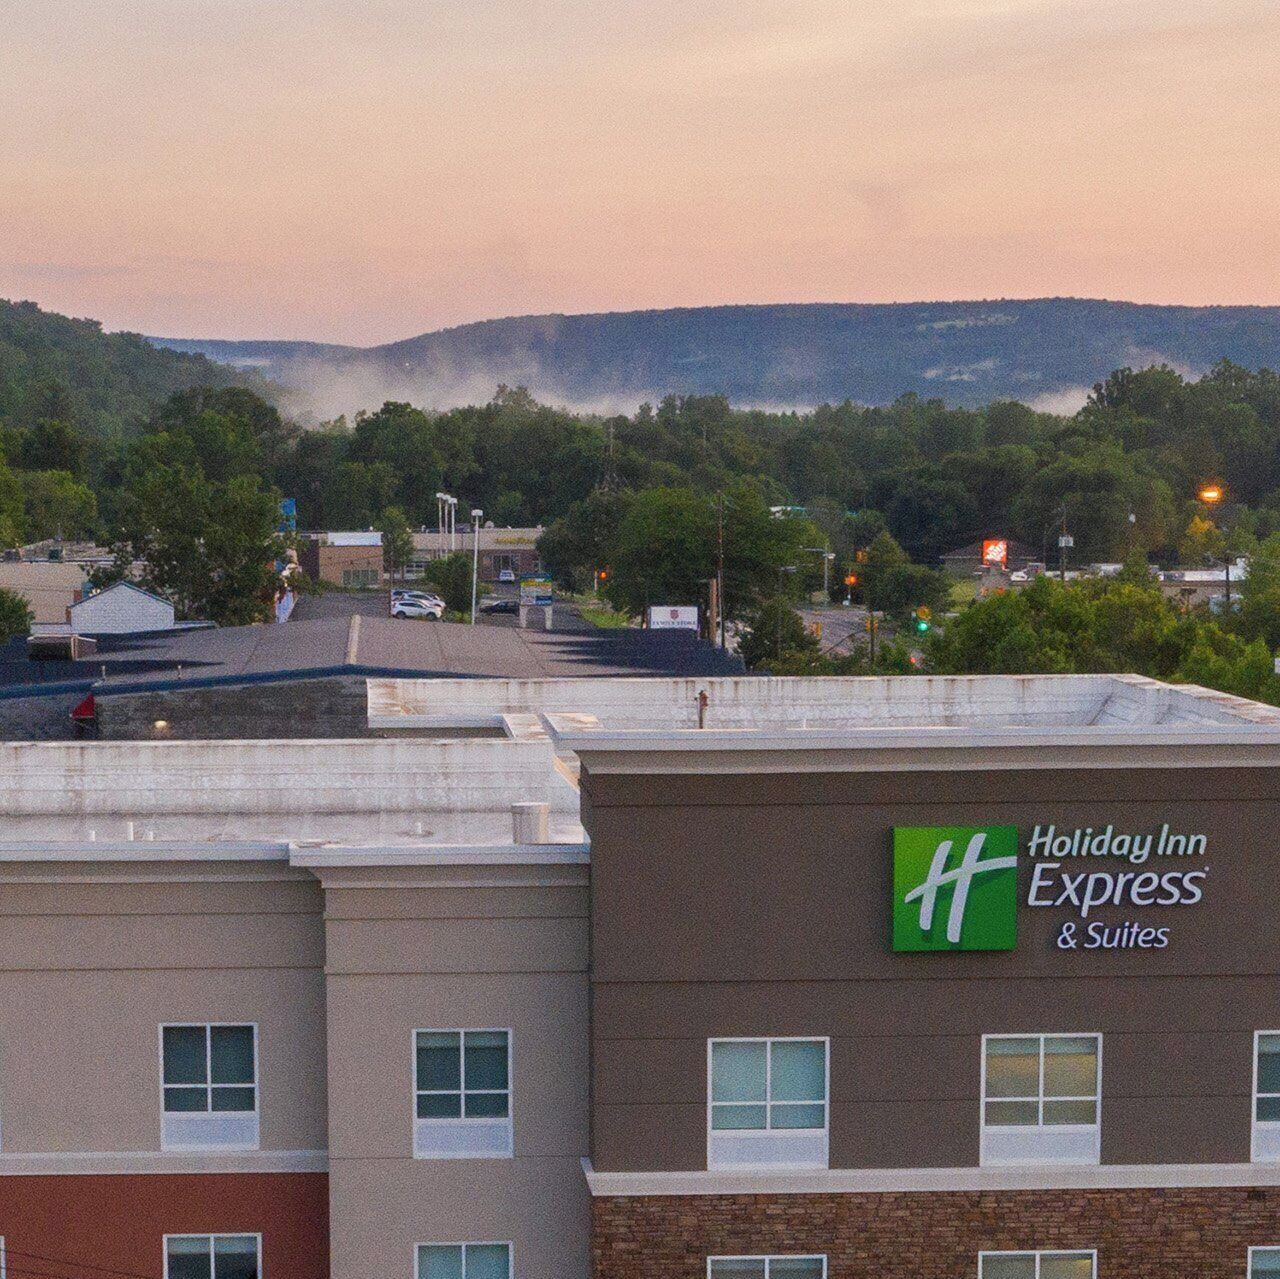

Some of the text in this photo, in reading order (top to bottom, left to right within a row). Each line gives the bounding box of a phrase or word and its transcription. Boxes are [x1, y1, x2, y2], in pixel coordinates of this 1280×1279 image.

[1027, 824, 1207, 864] Holiday Inn
[1027, 862, 1207, 918] Express
[1057, 921, 1170, 949] & Suites
